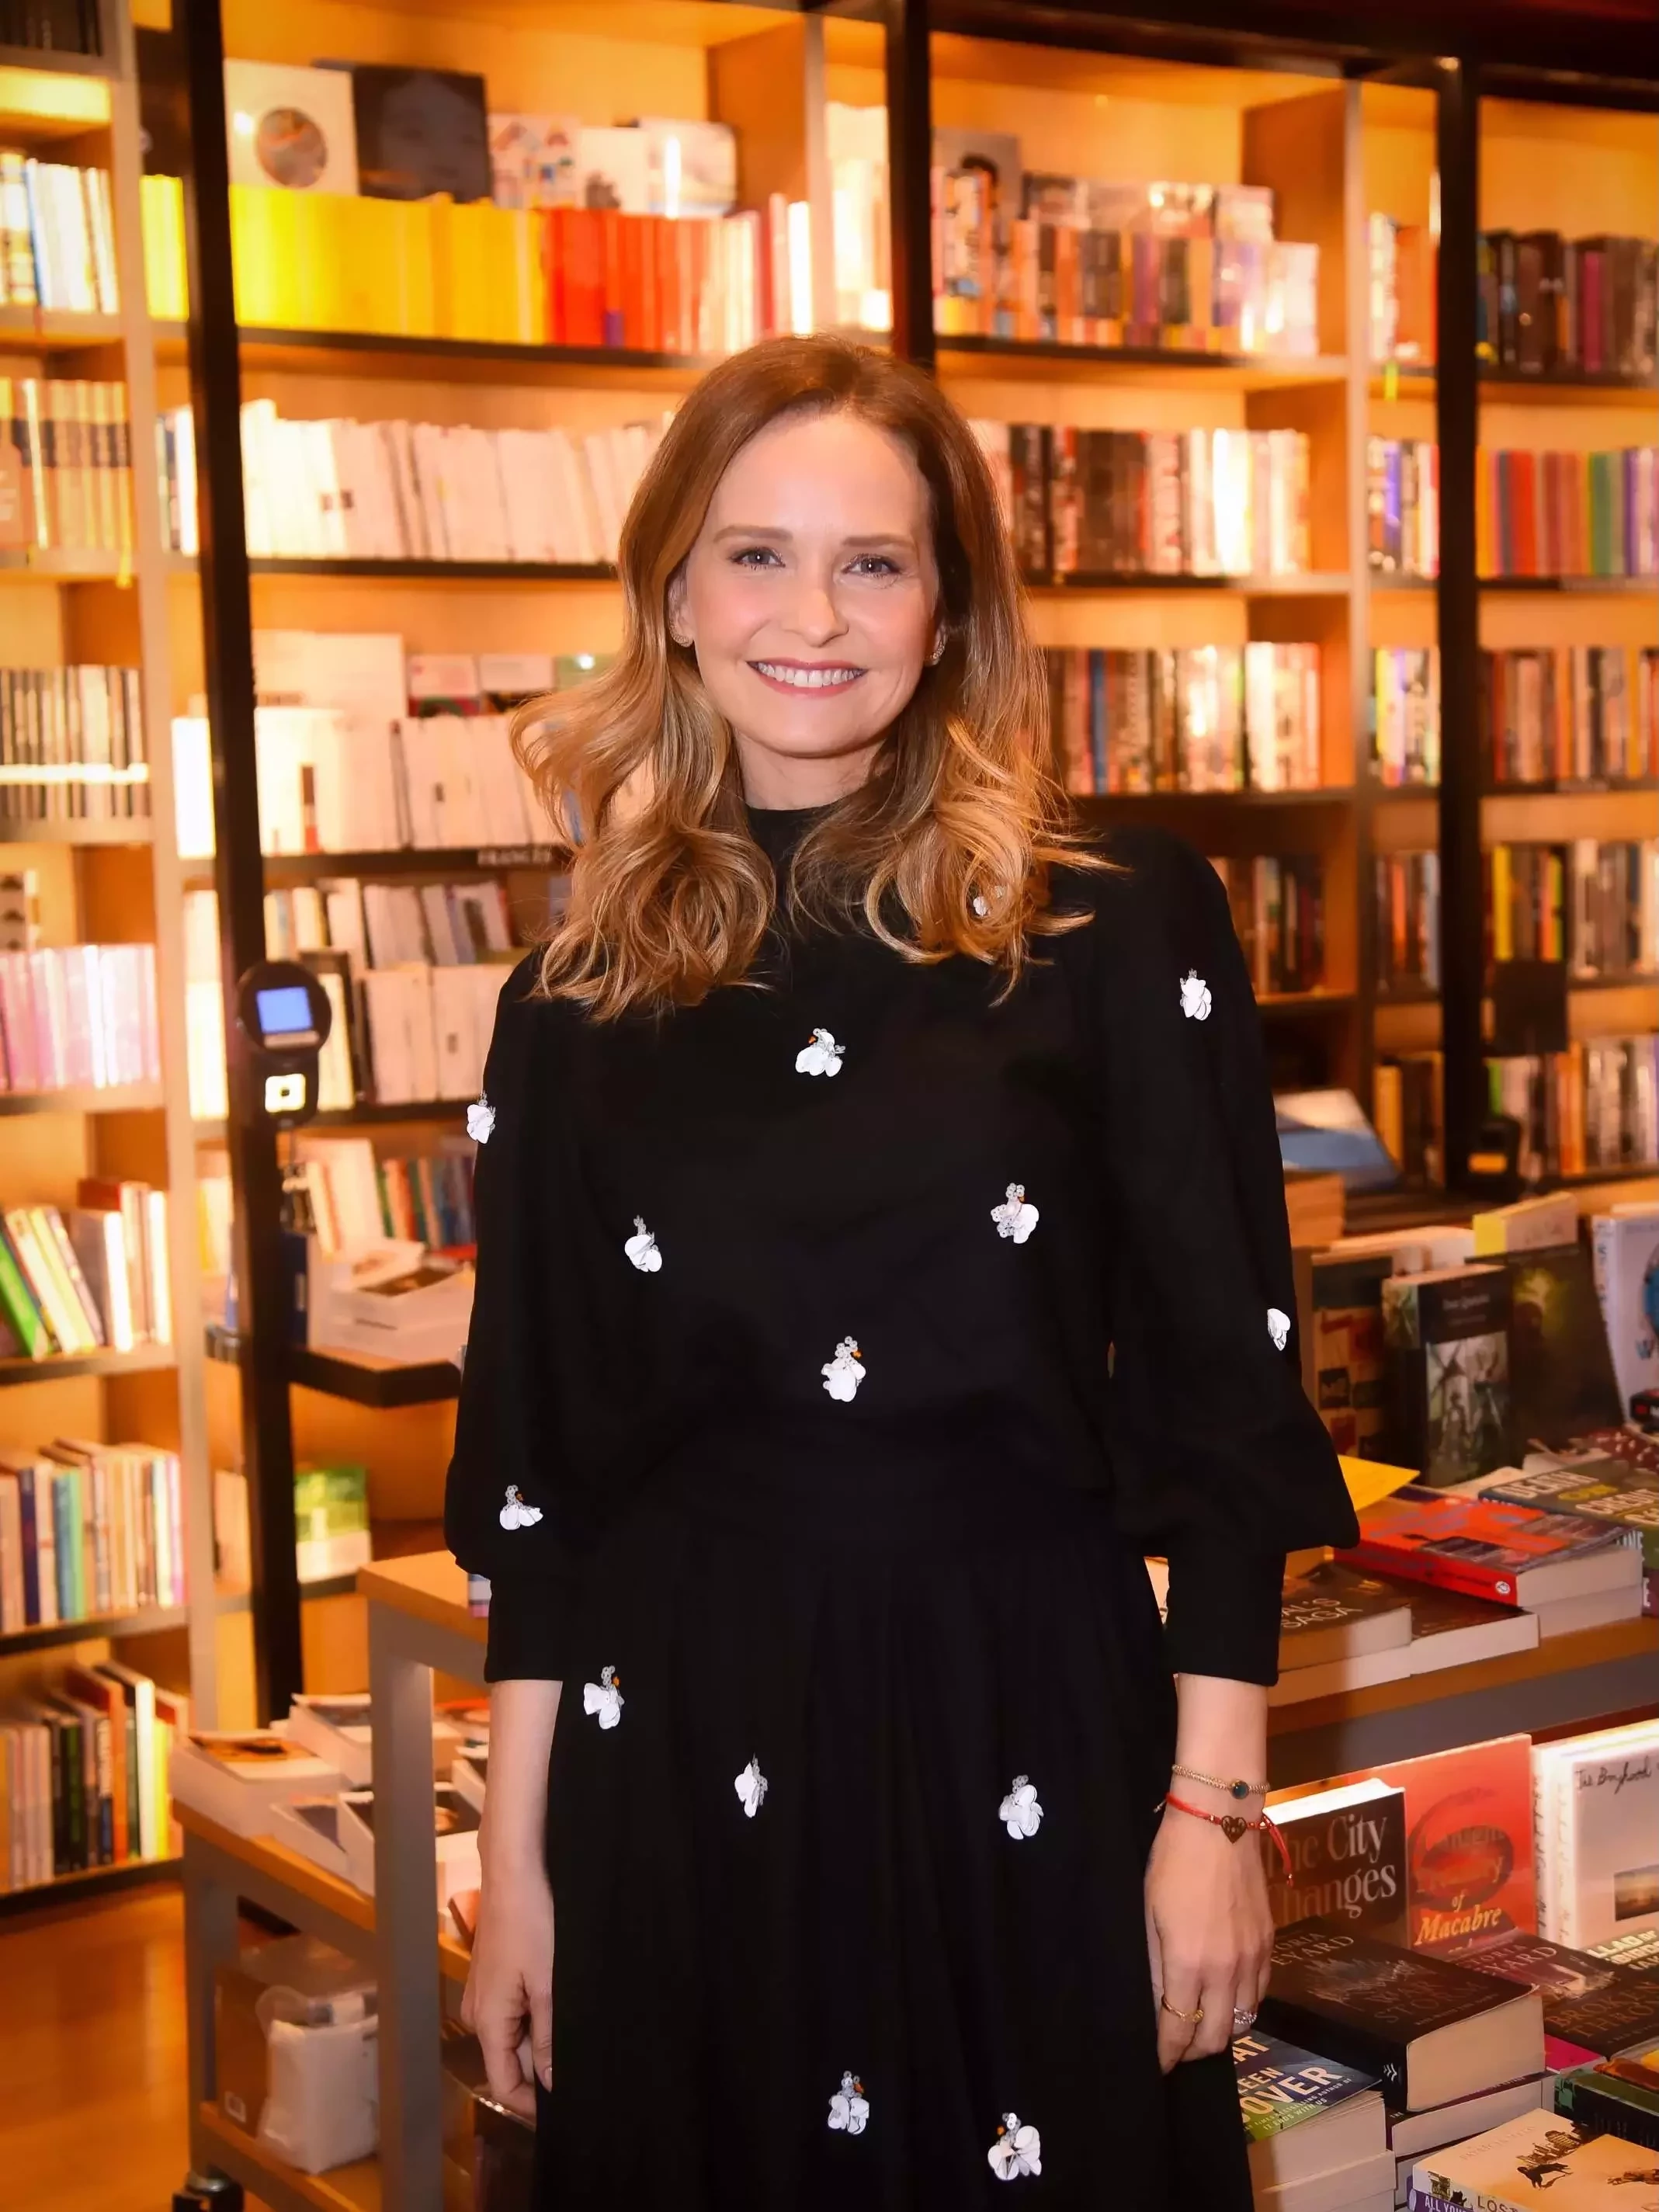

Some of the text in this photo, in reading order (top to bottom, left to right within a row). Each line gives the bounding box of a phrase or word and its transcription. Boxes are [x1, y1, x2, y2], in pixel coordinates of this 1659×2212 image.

[1282, 1598, 1341, 1616] AL'S
[1328, 1813, 1387, 1863] City
[1267, 1864, 1397, 1925] hanges
[1451, 1889, 1468, 1913] of
[1414, 1905, 1502, 1946] Macabre
[1270, 1935, 1355, 1966] EYARD
[1275, 1932, 1326, 1950] ORIA
[1586, 1936, 1643, 1959] LLAD
[1481, 1946, 1557, 1976] YARD
[1232, 2036, 1270, 2065] AT
[1237, 2067, 1285, 2095] LEEN
[1240, 2067, 1343, 2123] OVER
[1315, 2097, 1328, 2106] US
[1425, 2195, 1441, 2212] ALL
